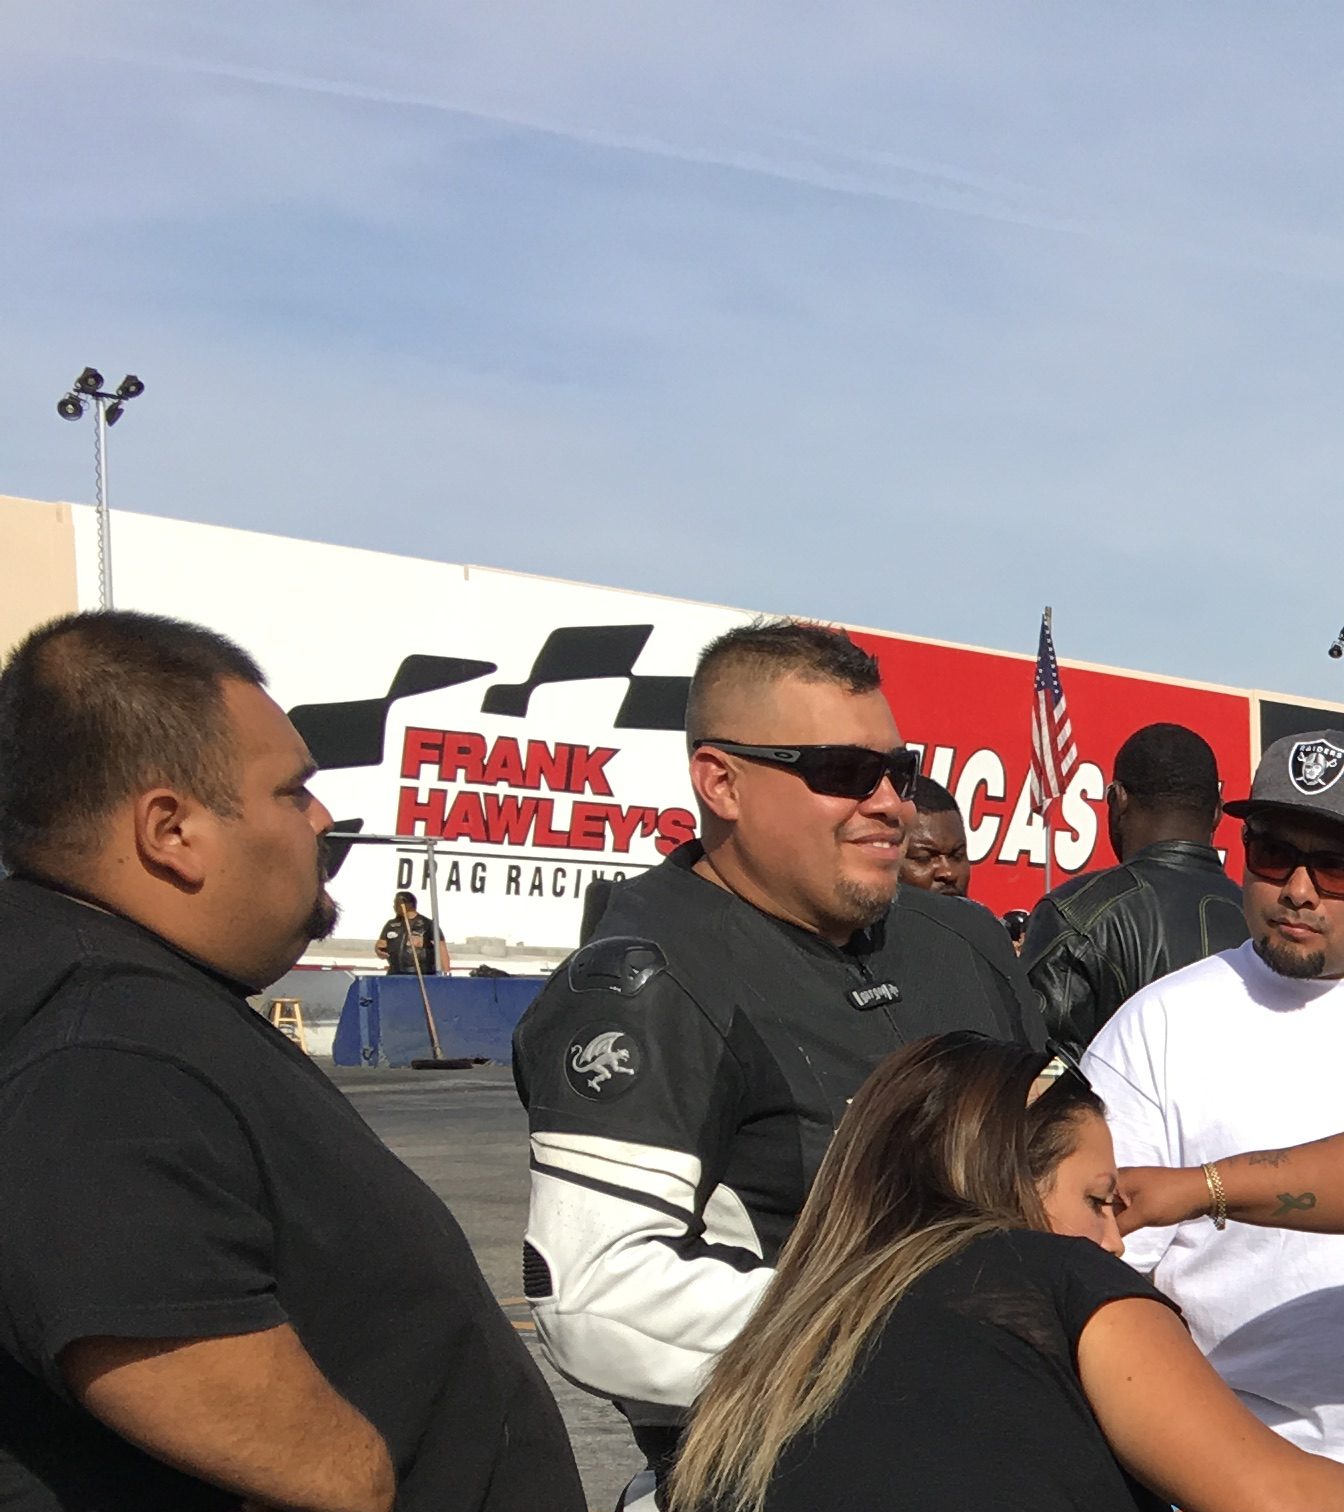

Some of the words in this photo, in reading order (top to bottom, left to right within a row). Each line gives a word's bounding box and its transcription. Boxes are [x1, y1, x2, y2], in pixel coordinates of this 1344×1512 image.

[400, 726, 622, 797] FRANK
[1299, 744, 1343, 759] RAIDERS
[395, 785, 697, 857] HAWLEY'S
[397, 857, 487, 893] DRAG
